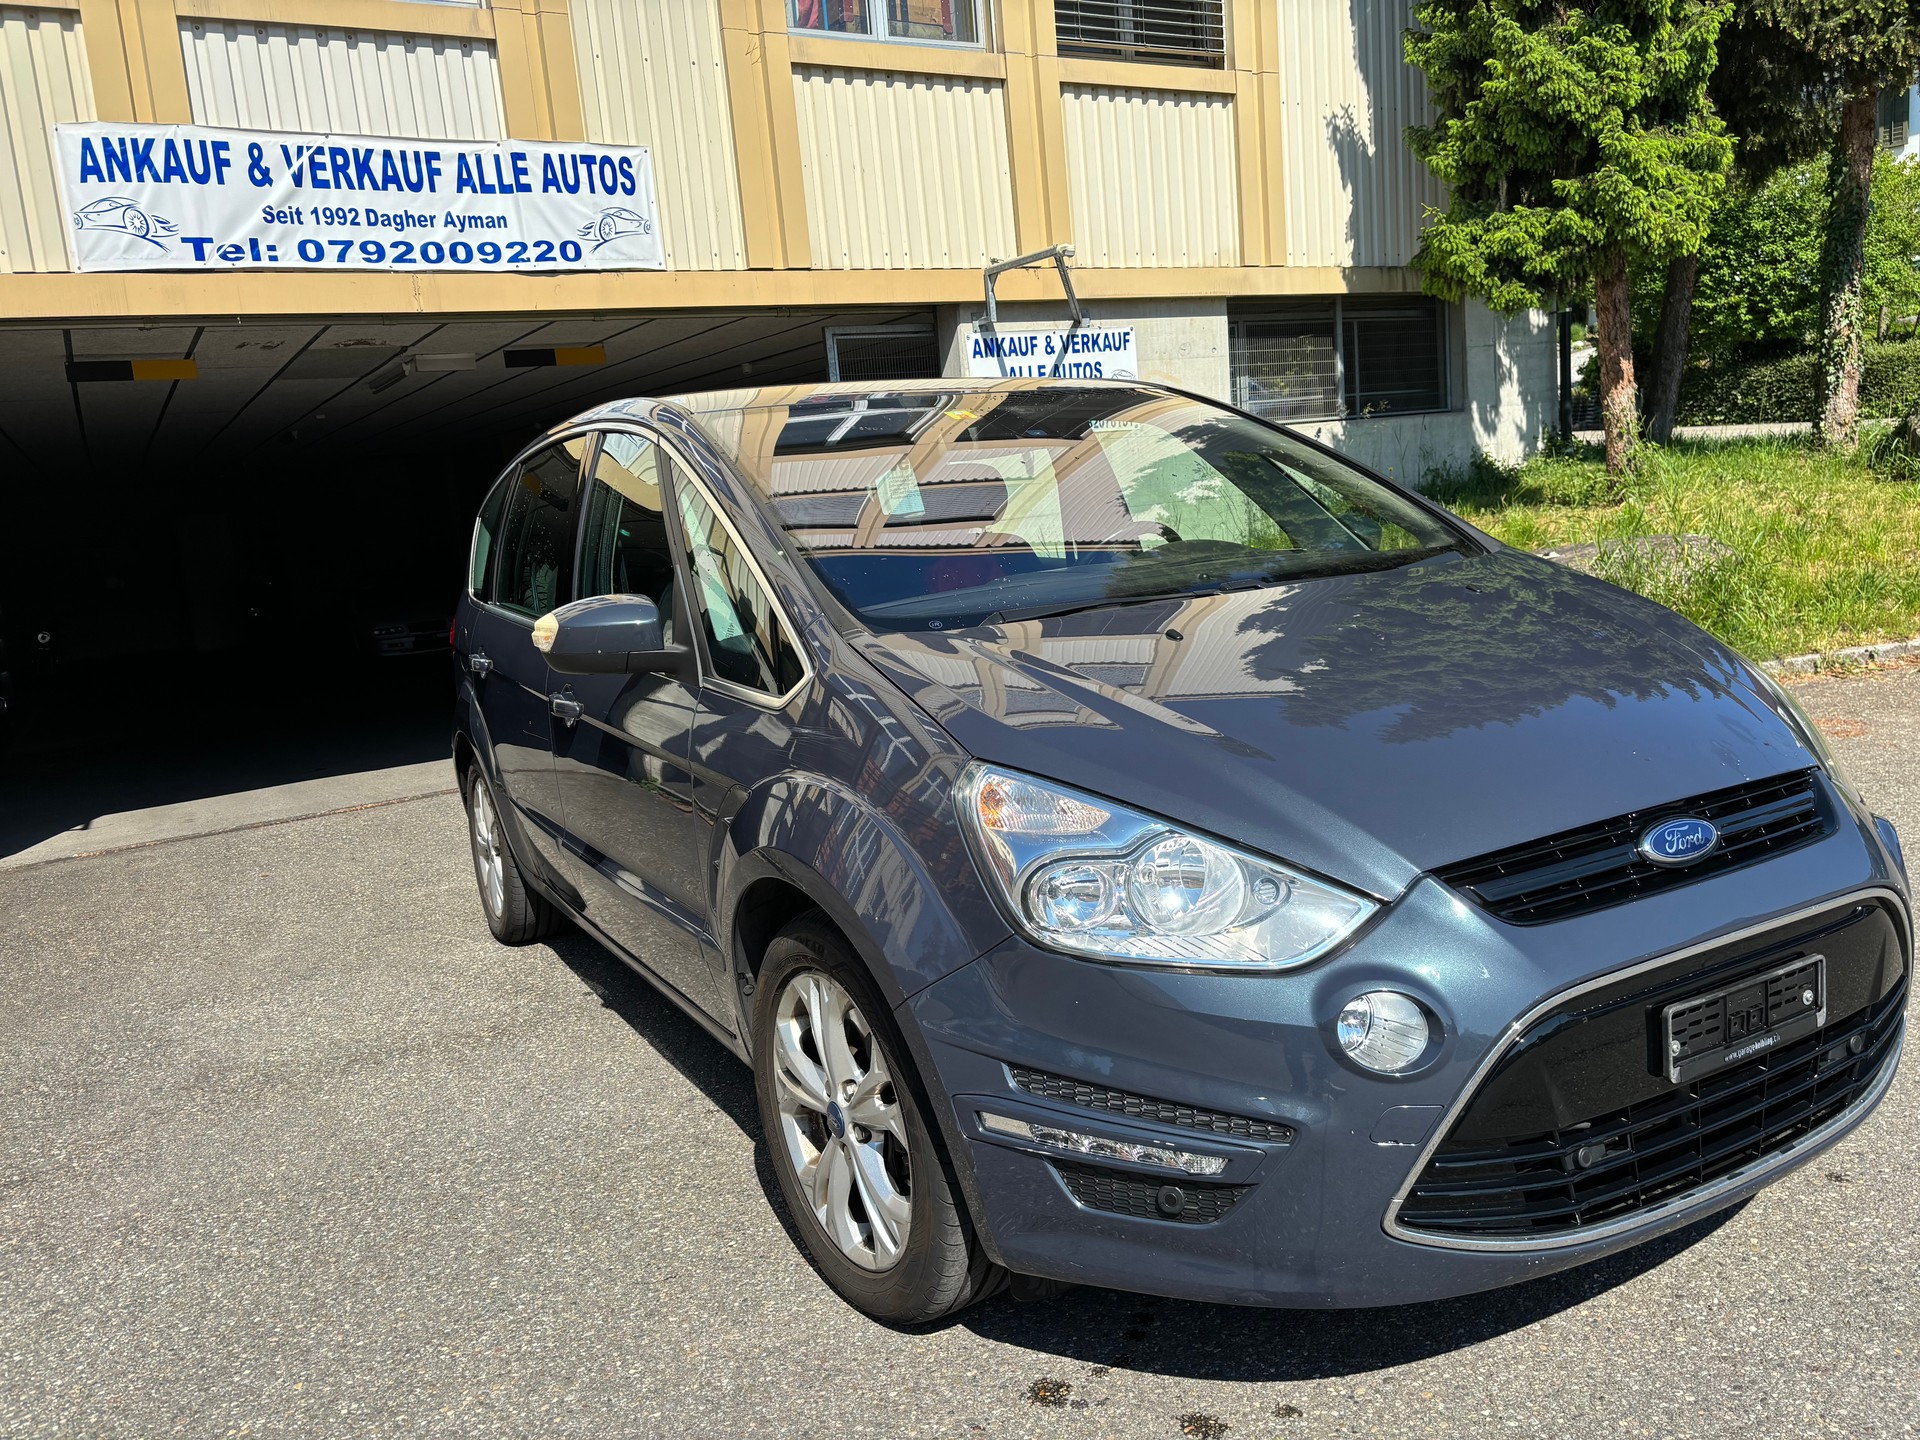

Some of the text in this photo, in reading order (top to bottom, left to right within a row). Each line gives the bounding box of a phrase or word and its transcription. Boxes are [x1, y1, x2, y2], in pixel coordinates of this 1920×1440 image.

[80, 136, 636, 196] ANKAUF & VERKAUF ALLE AUTOS
[262, 204, 508, 233] Seit 1992 Dagher Ayman
[180, 236, 583, 264] Tel: 0792009220
[972, 331, 1131, 359] ANKAUF & VERKAUF
[1053, 361, 1103, 379] AUTOS
[1664, 825, 1705, 853] Ford
